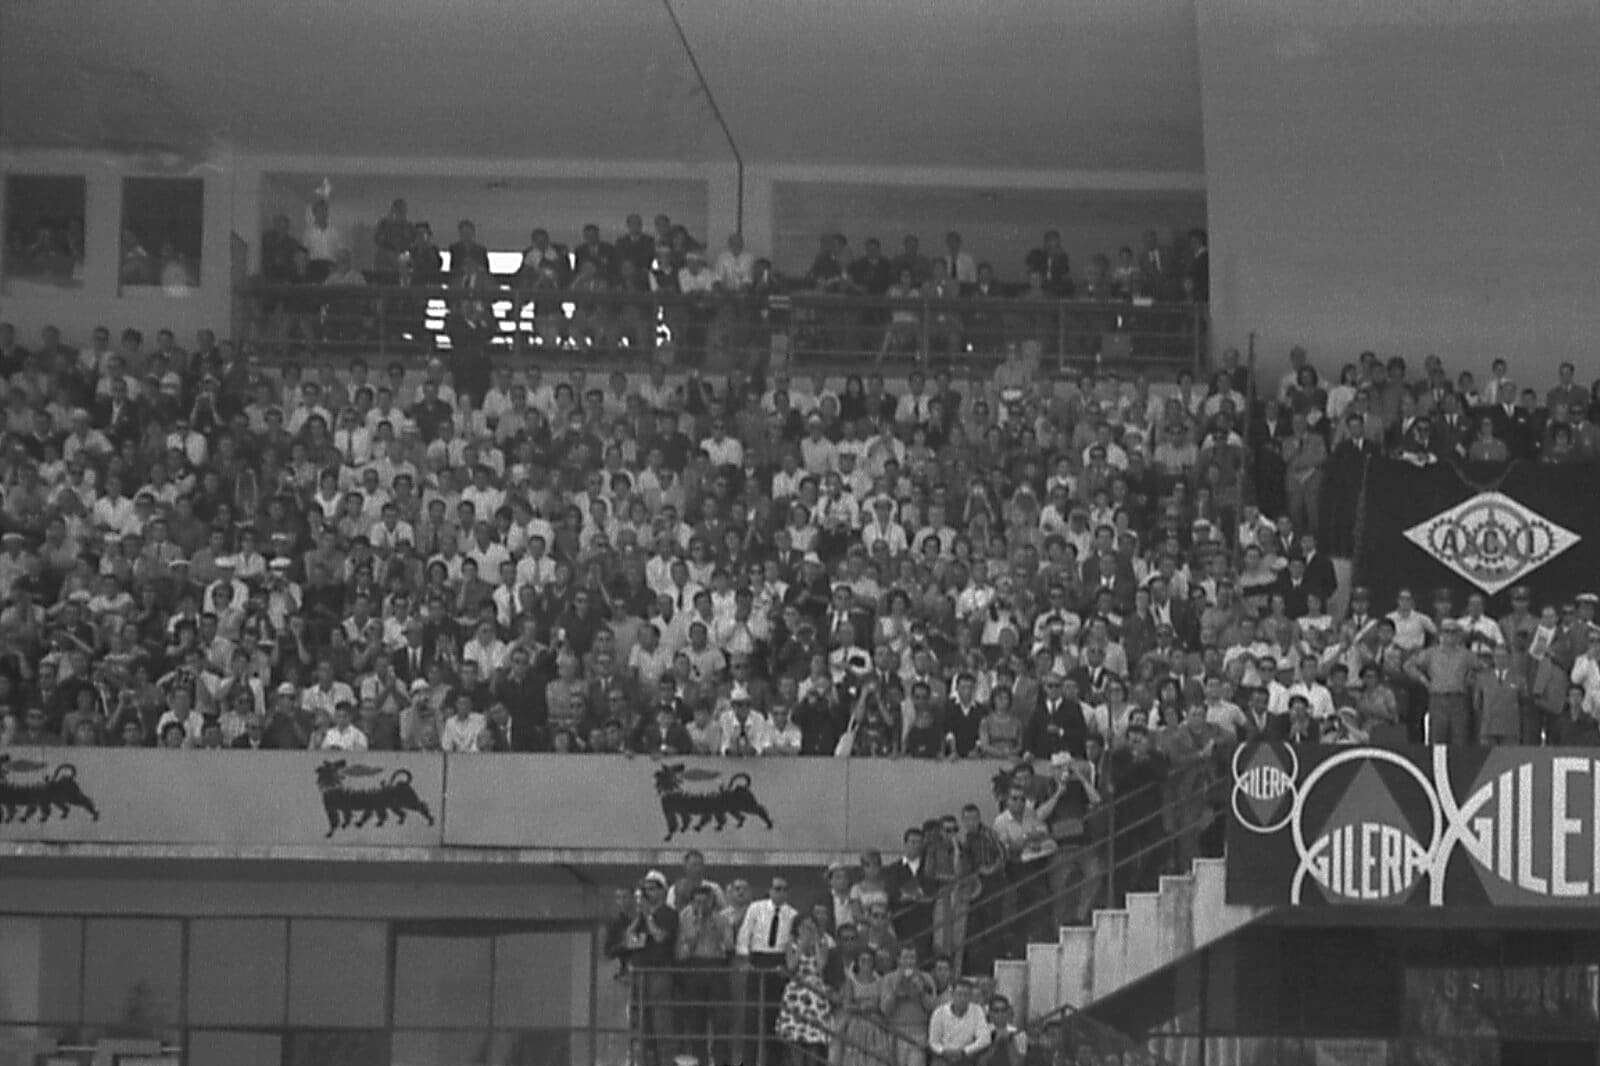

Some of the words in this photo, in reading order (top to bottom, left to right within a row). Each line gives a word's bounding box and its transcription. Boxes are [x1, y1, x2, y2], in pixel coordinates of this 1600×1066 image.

[1443, 526, 1535, 555] ACI
[1238, 766, 1292, 799] GILERA
[1305, 821, 1428, 899] GILERA
